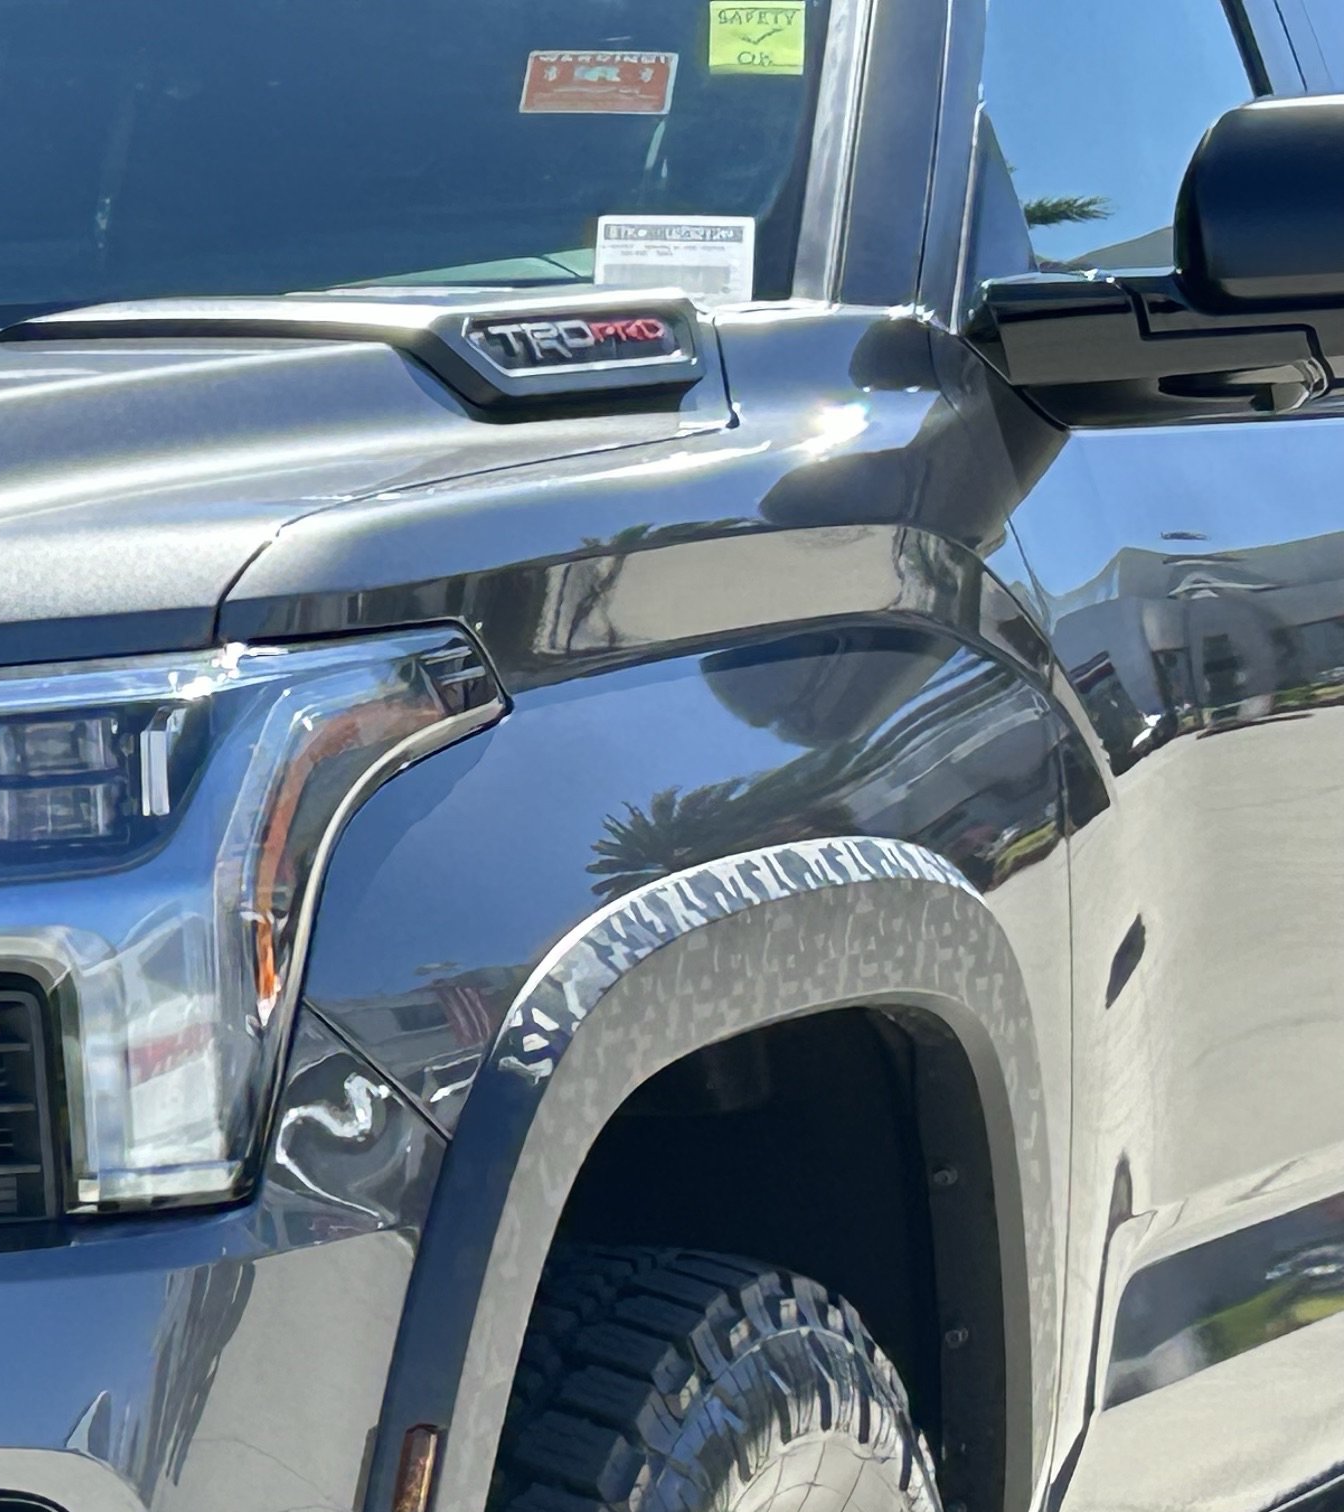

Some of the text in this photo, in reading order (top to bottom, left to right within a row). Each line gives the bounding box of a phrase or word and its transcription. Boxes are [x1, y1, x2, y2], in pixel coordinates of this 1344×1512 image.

[717, 9, 799, 25] SAFETY
[486, 317, 664, 360] TRD PRO
